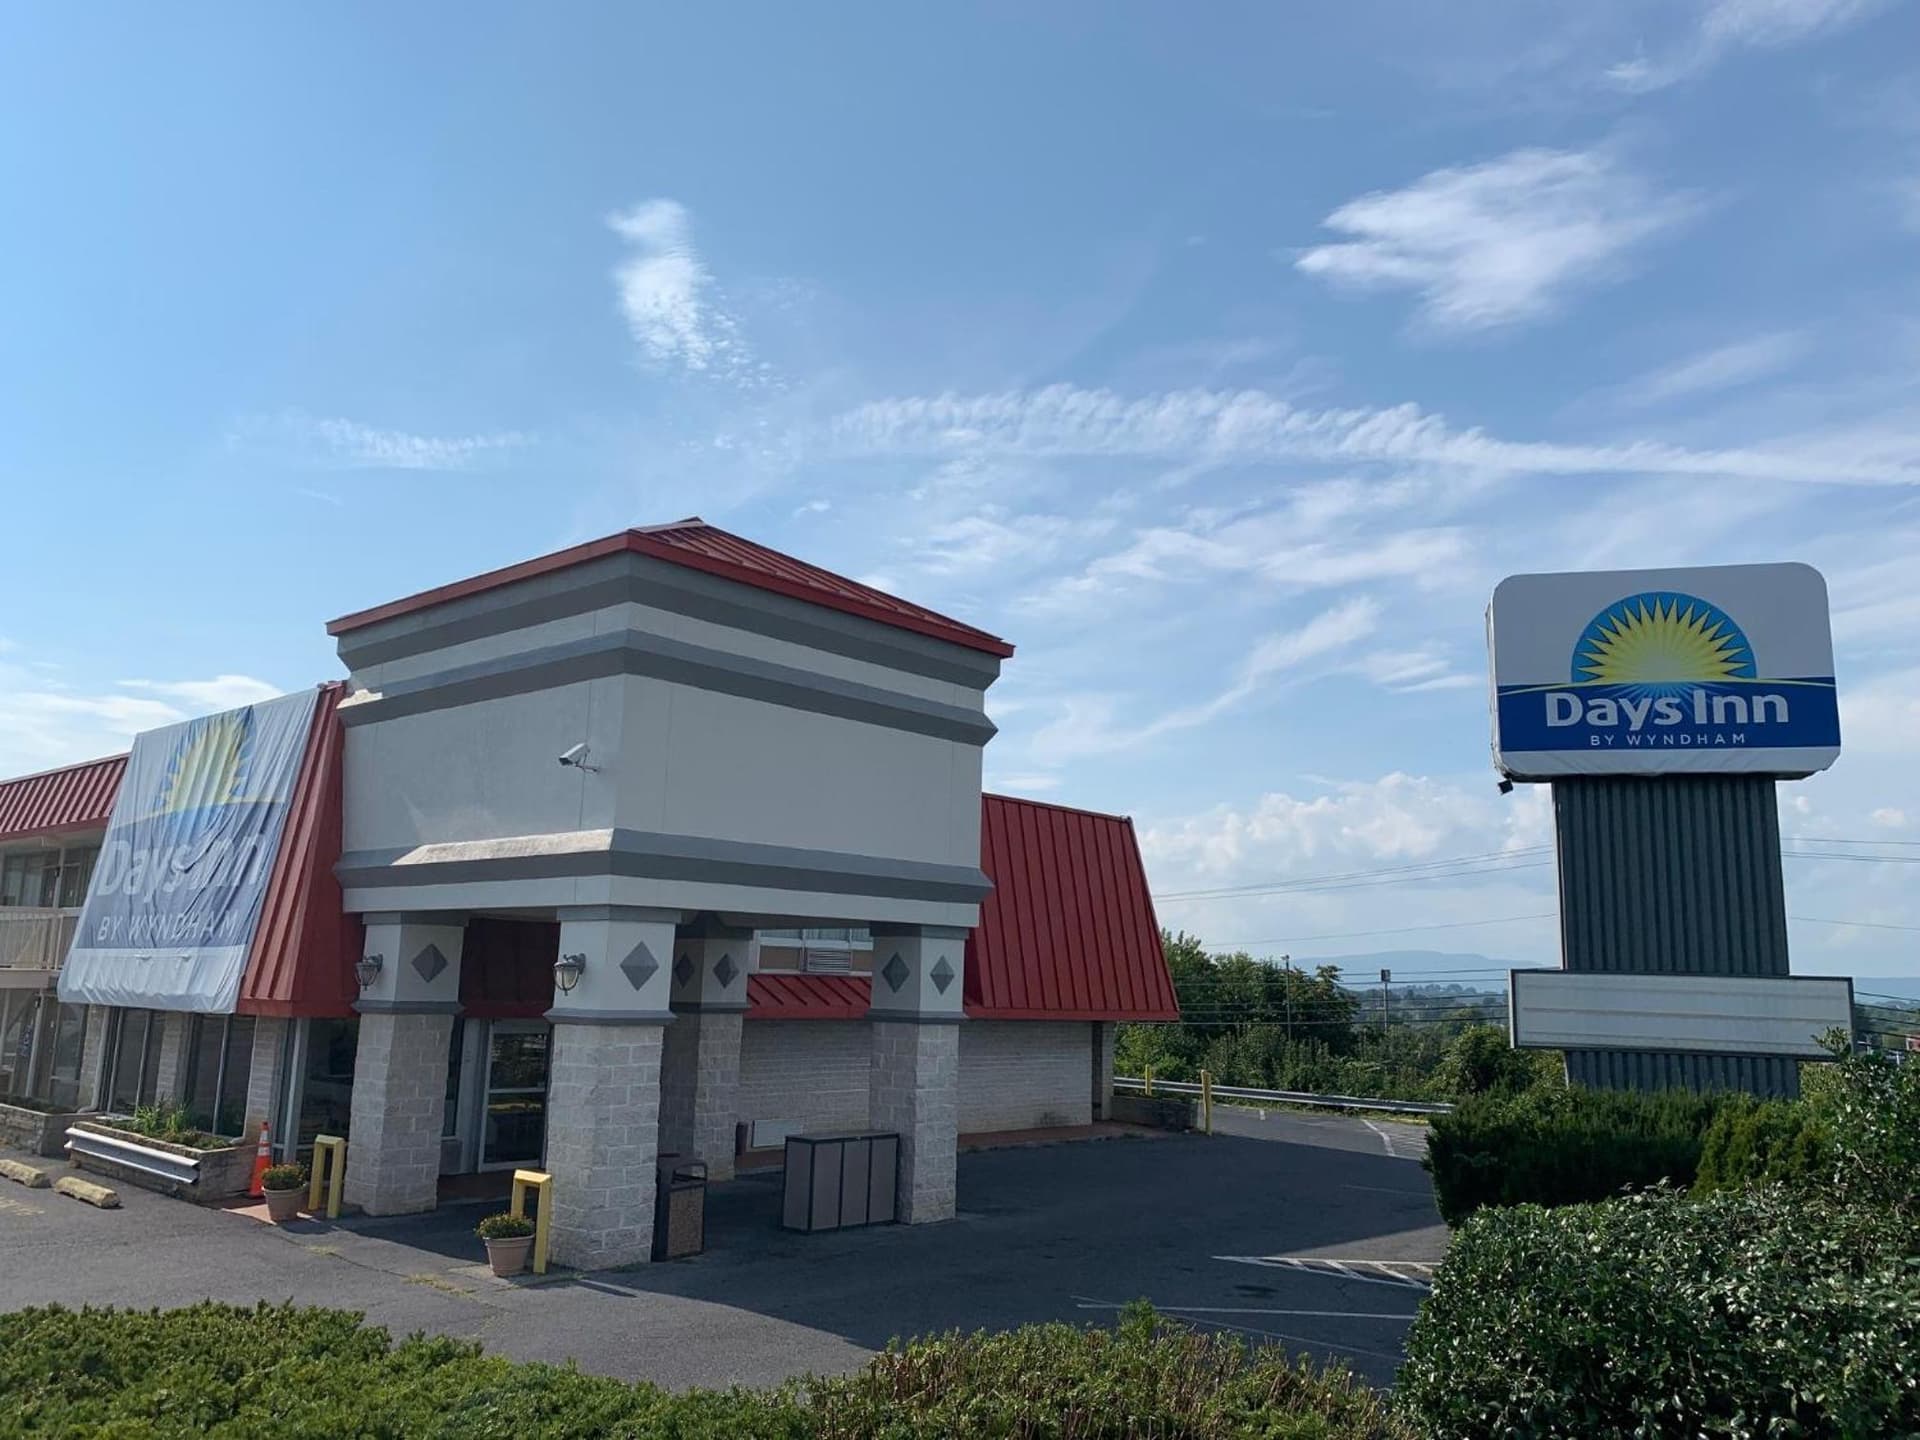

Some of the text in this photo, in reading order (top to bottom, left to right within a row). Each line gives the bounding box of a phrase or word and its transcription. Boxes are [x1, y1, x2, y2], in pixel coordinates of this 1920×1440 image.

[1545, 689, 1789, 731] Days Inn
[1590, 733, 1746, 746] BY WYNDHAM
[98, 916, 122, 941] BY
